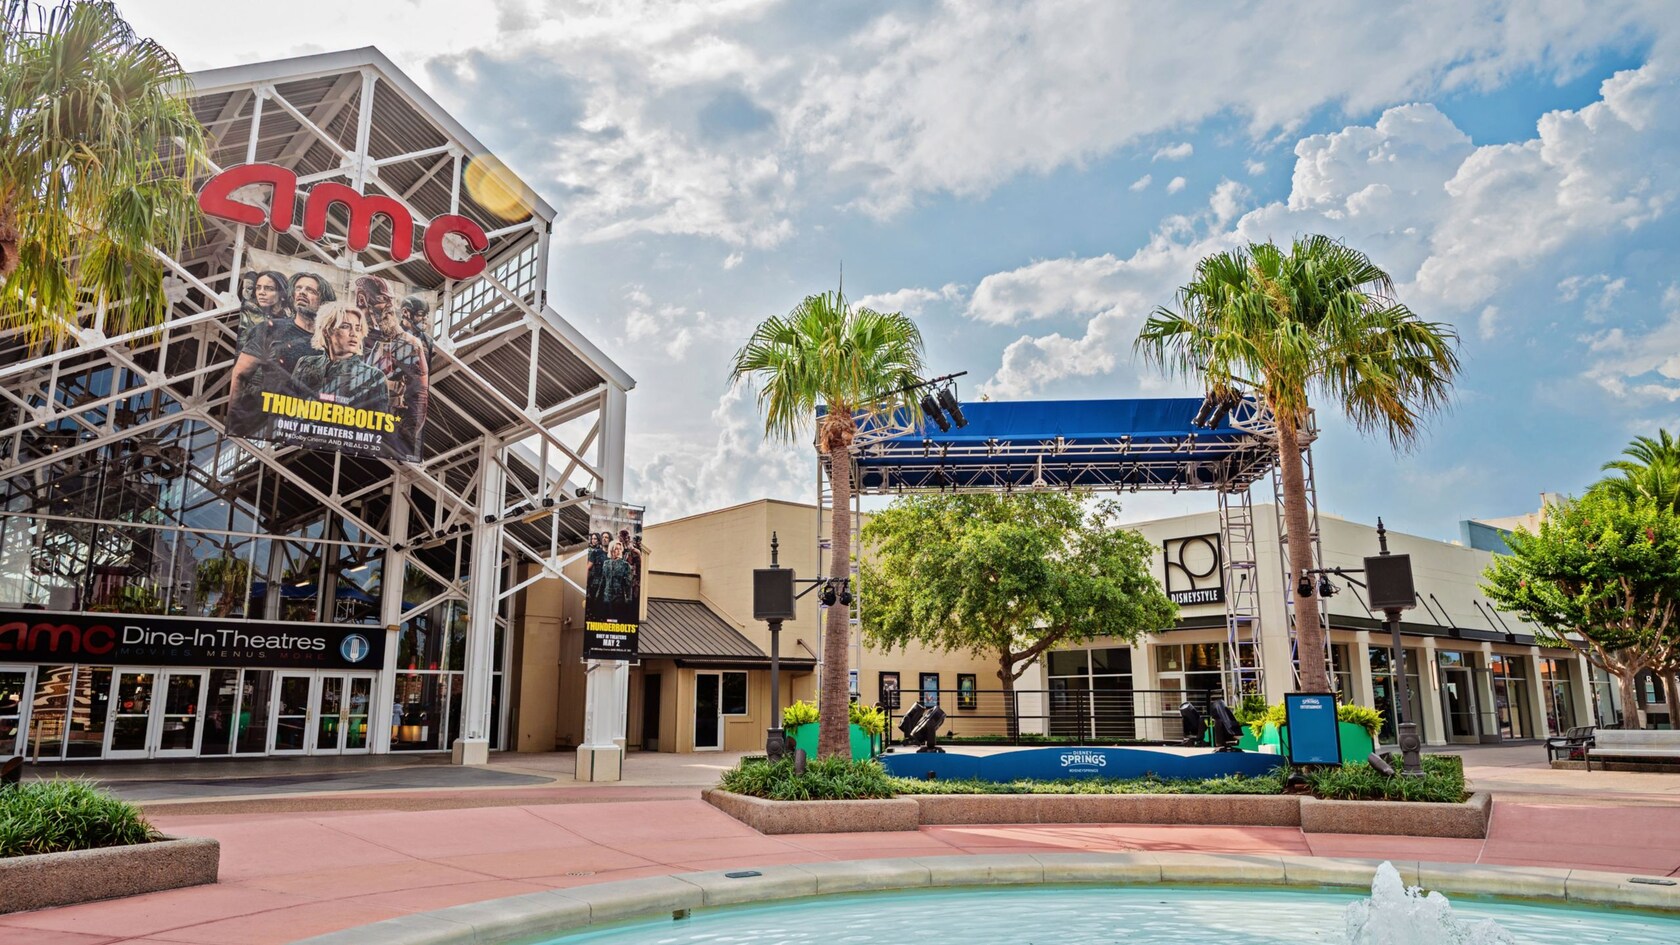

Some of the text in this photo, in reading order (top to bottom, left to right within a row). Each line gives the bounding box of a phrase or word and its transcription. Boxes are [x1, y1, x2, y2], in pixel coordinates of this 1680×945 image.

[277, 419, 382, 444] ONLY IN THEATERS MAY 2
[292, 433, 307, 442] Dolby
[1171, 590, 1218, 604] DISNEYSTYLE
[602, 639, 615, 647] MAY
[1060, 755, 1107, 767] SPRINGS
